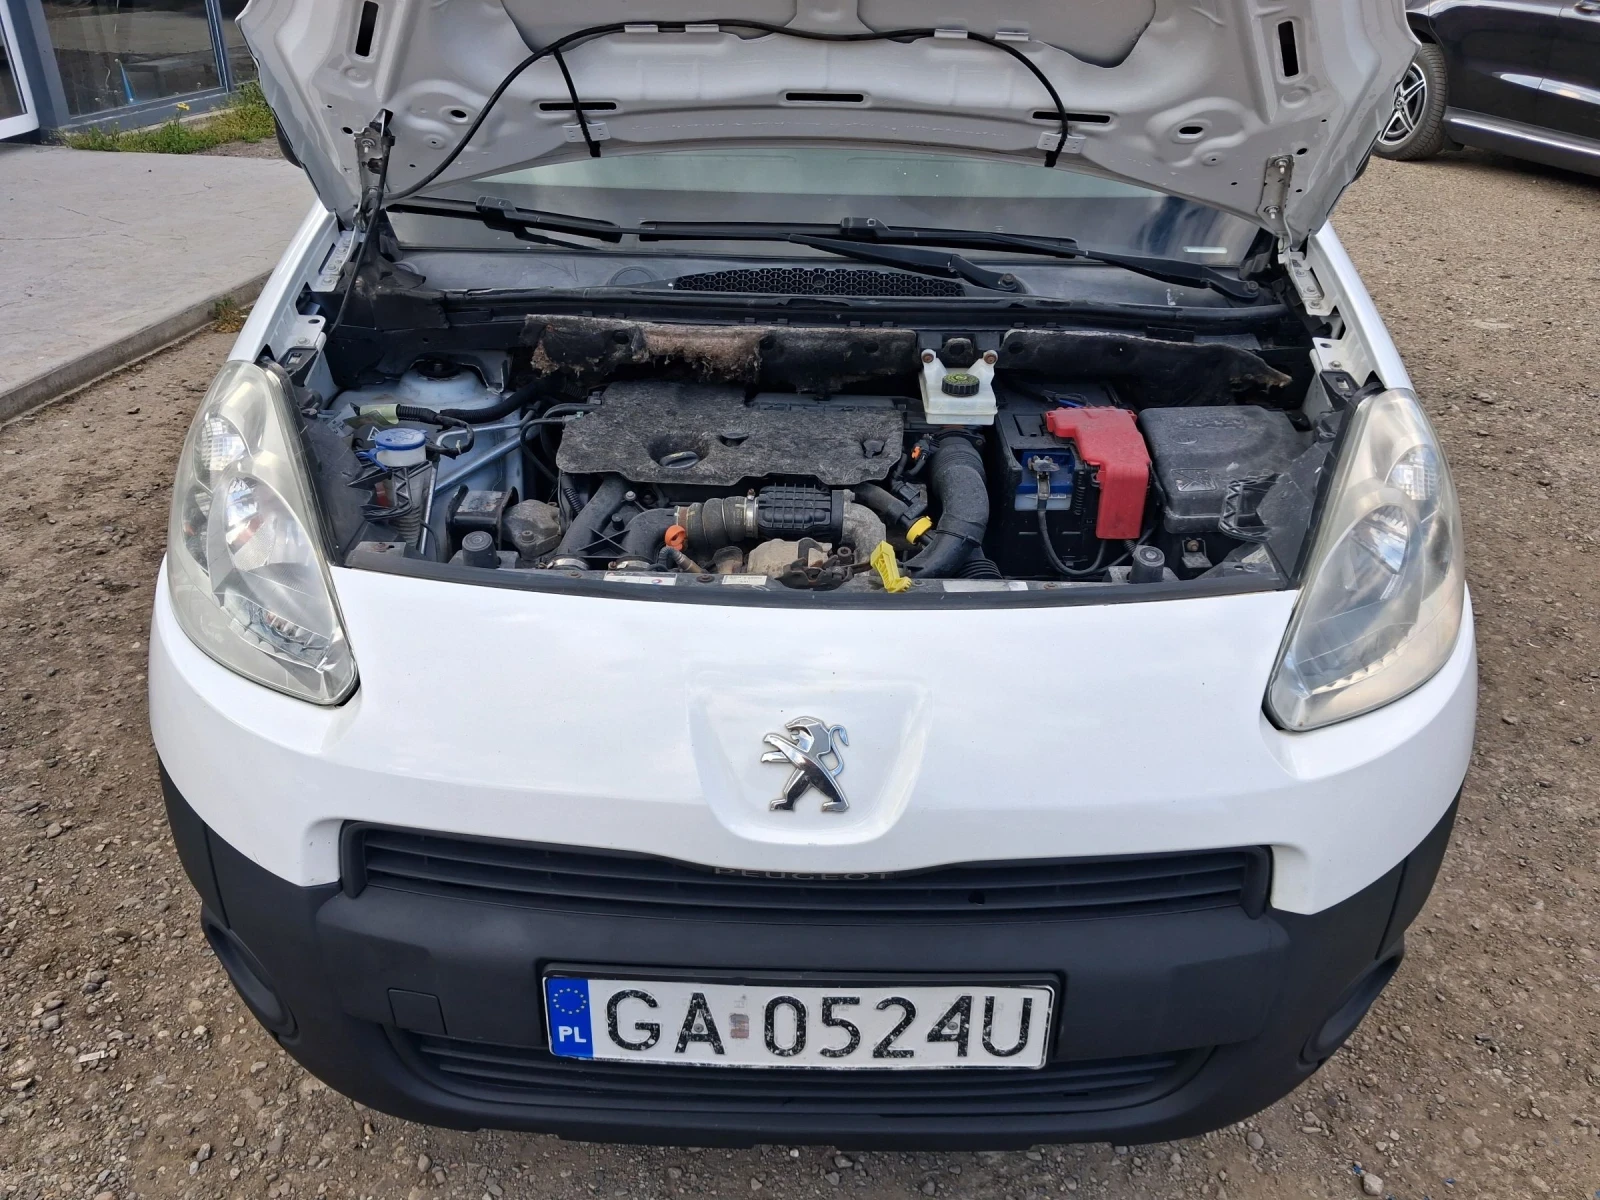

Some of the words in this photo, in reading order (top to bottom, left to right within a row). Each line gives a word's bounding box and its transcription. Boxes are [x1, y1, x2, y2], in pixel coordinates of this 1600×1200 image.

[558, 1025, 587, 1043] PL
[606, 989, 726, 1055] GA
[764, 994, 1033, 1058] 0524U
